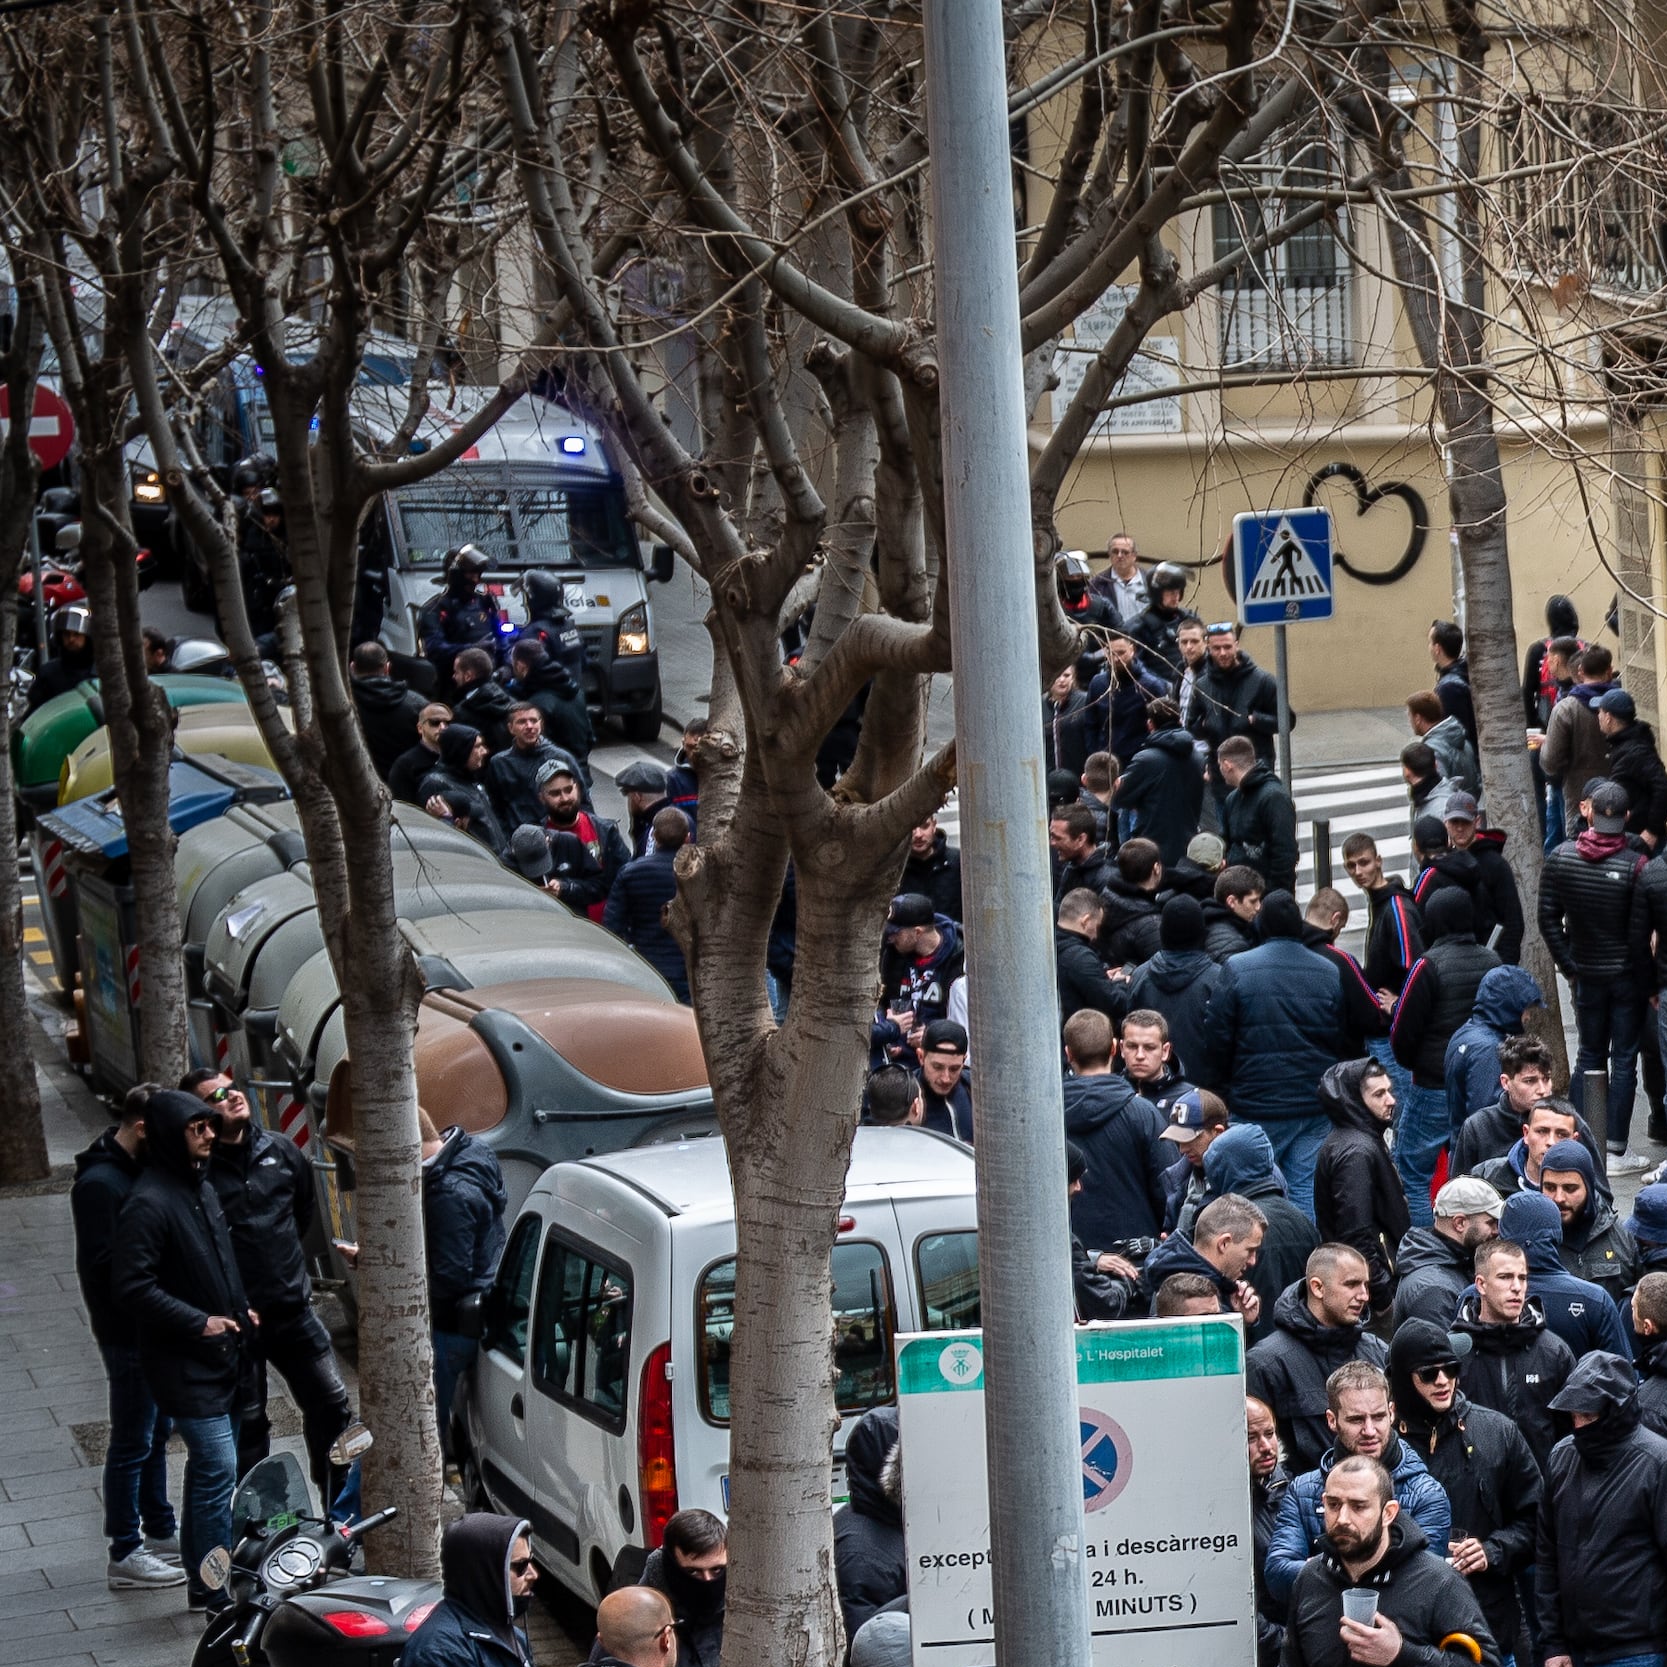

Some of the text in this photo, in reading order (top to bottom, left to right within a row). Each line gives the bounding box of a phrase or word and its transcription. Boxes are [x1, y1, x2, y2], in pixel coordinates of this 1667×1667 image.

[565, 597, 597, 607] icia
[1086, 1346, 1164, 1363] L'Hospitalet
[1116, 1533, 1239, 1558] descàrrega
[1091, 1568, 1144, 1588] 24 h.
[1095, 1594, 1184, 1618] MINUTS
